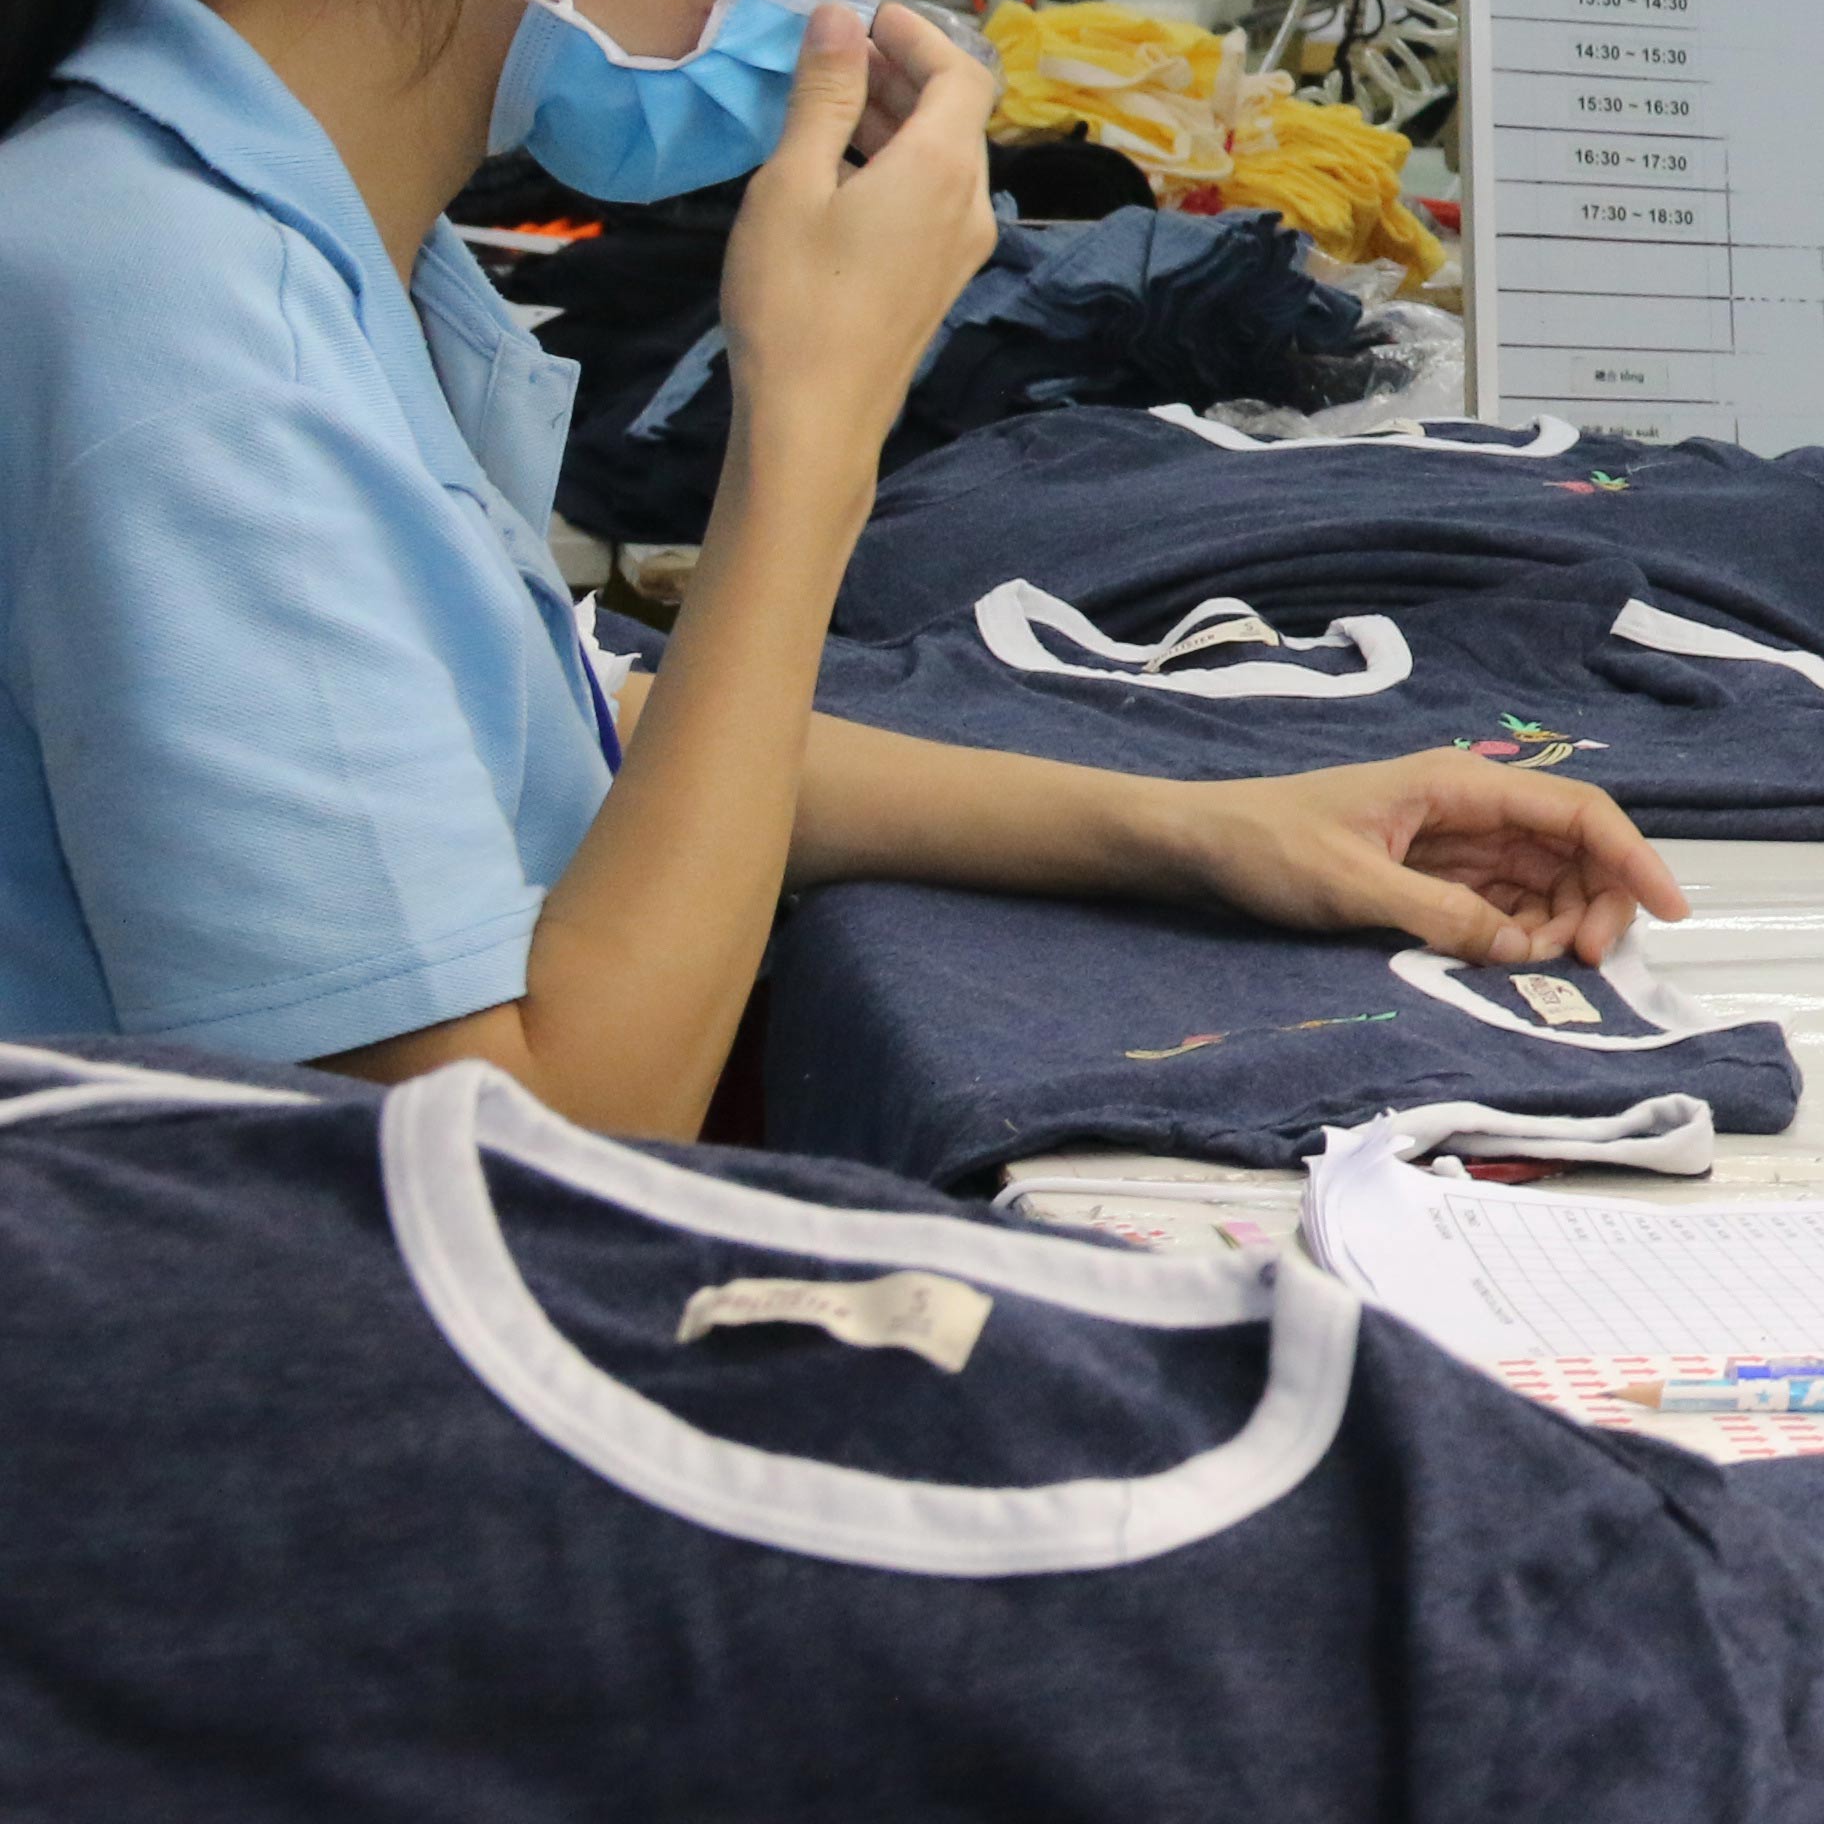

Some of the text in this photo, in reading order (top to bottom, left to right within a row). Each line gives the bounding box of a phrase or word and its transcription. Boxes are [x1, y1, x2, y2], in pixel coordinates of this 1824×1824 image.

[1575, 43, 1621, 62] 14:30
[1642, 47, 1688, 65] 15:30
[1577, 95, 1623, 113] 15:30
[1644, 99, 1690, 117] 16:30
[1575, 149, 1620, 167] 16:30
[1642, 153, 1688, 172] 17:30
[1581, 204, 1627, 223] 17:30
[1648, 208, 1694, 226] 18:30
